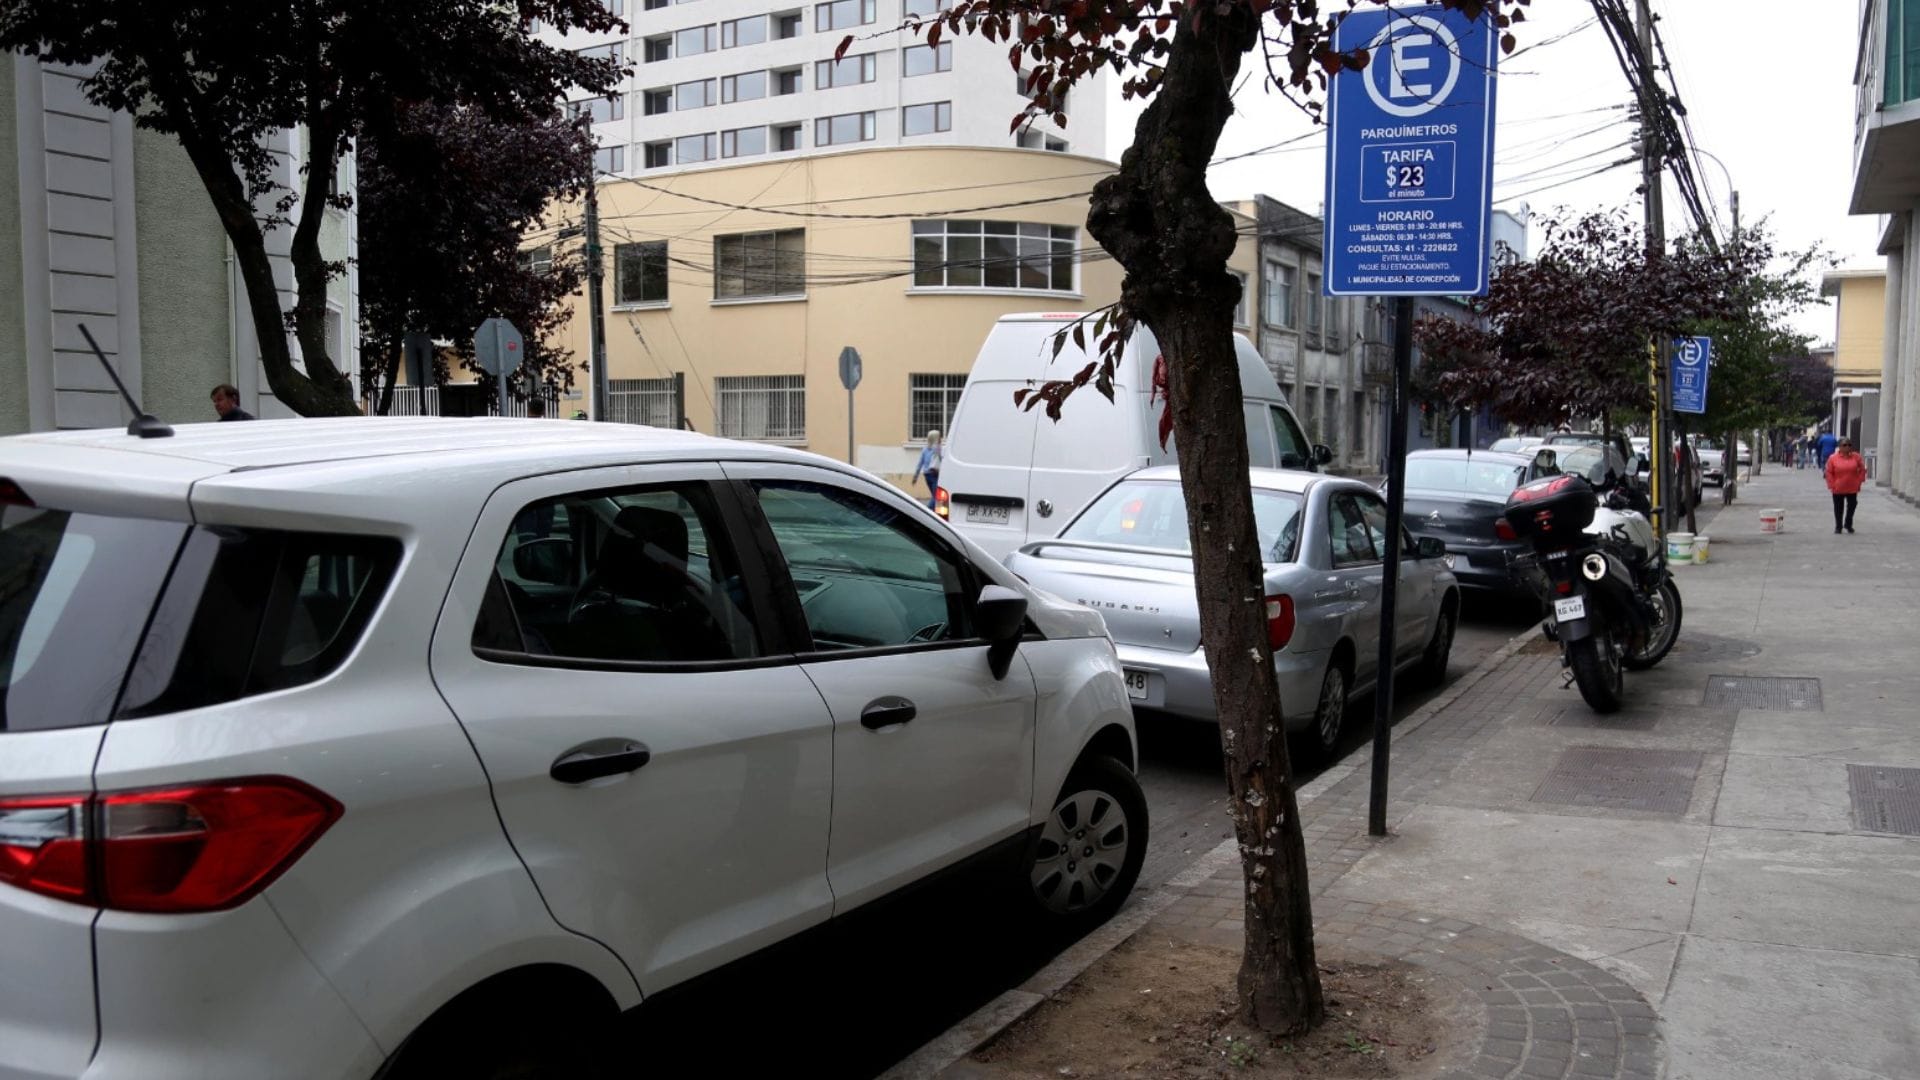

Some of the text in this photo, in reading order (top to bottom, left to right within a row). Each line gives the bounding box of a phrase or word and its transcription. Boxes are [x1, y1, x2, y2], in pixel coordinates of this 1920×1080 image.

[1390, 34, 1432, 98] E
[1361, 124, 1457, 139] PARQUÍMETROS
[1382, 149, 1434, 163] TARIFA
[1400, 166, 1424, 187] 23
[1388, 189, 1425, 198] el minuto
[1378, 210, 1434, 221] HORARIO
[1349, 224, 1371, 232] LUNES
[1376, 223, 1406, 231] VIERNES:
[1448, 221, 1464, 229] HRS.
[1361, 233, 1395, 241] SÁBADOS:
[1437, 232, 1453, 240] HRS.
[1347, 244, 1403, 253] CONSULTAS:
[1405, 244, 1415, 252] 41
[1382, 254, 1400, 262] EVITE
[1358, 263, 1379, 271] PAGUE
[1380, 263, 1389, 271] SU
[1353, 275, 1404, 283] MUNICIPALIDAD
[1405, 275, 1415, 283] DE
[1416, 273, 1460, 283] CONCEPCIÓN
